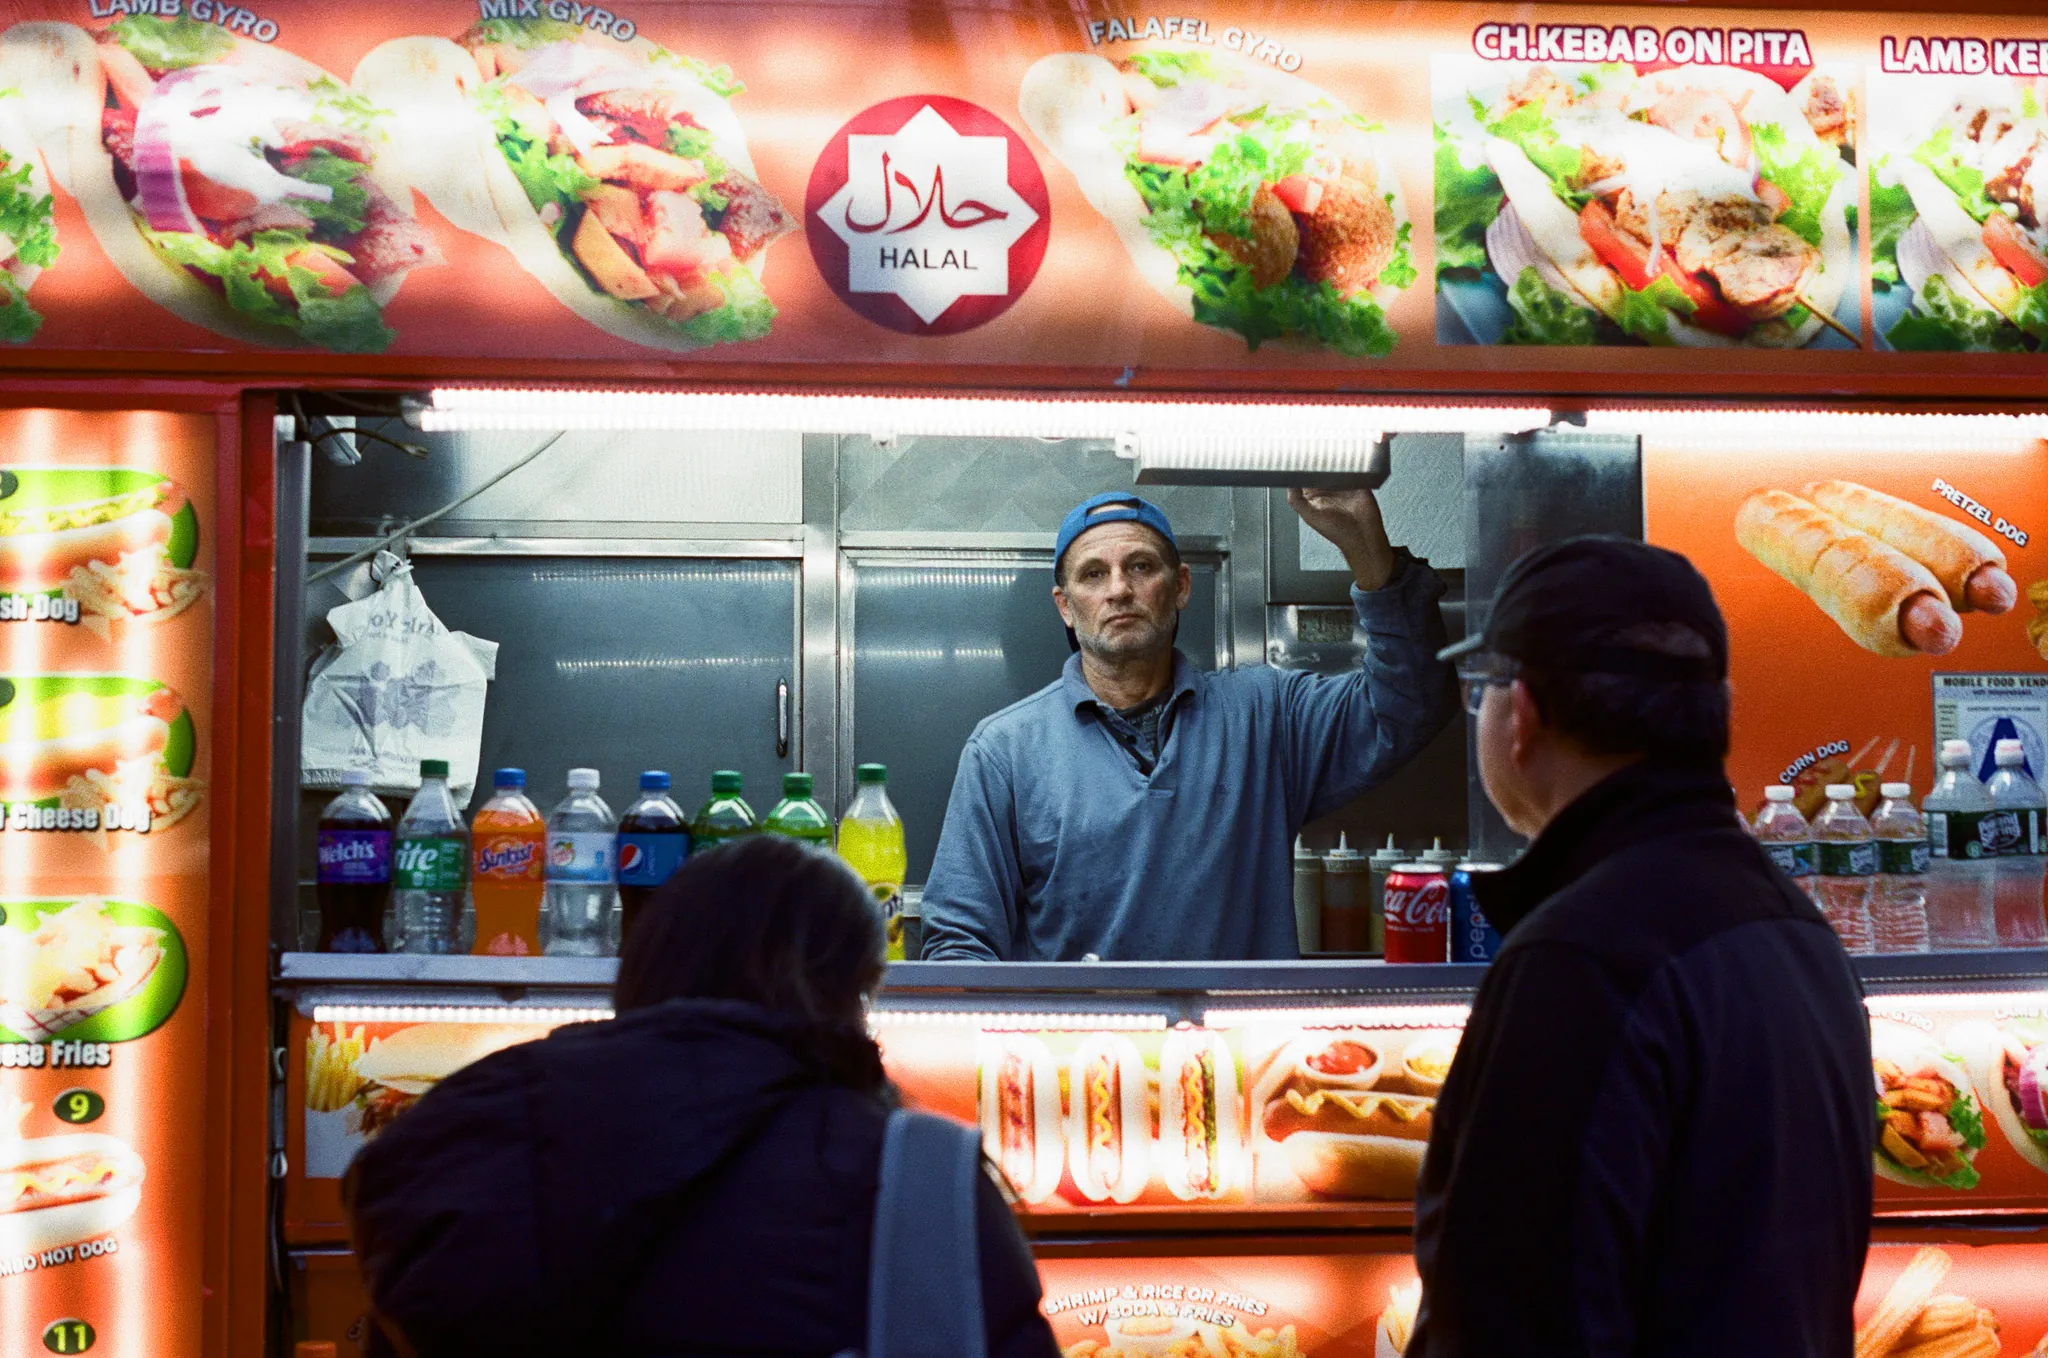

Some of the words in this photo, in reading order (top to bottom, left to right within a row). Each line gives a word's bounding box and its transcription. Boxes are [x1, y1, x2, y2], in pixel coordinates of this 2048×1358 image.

[91, 0, 182, 18] LAMB
[190, 0, 279, 43] GYRO
[480, 0, 539, 19] MIX
[548, 0, 636, 41] GYRO
[1088, 16, 1215, 45] FALAFEL
[1222, 26, 1303, 72] GYRO
[1472, 23, 1660, 64] CH.KEBAB
[1664, 28, 1724, 66] ON
[1728, 29, 1814, 67] PITA
[1882, 37, 1988, 74] LAMB
[845, 151, 1009, 235] حلال
[880, 247, 978, 270] HALAL
[1932, 478, 1993, 527] PRETZEL
[1993, 517, 2029, 548] DOG
[33, 593, 80, 624] Dog
[1943, 677, 1983, 687] MOBILE
[1985, 677, 2016, 687] FOOD
[1779, 751, 1817, 784] CORN
[1816, 740, 1850, 759] DOG
[11, 803, 98, 830] Cheese
[104, 803, 151, 833] Dog
[51, 1040, 111, 1067] Fries
[69, 1093, 90, 1121] 9
[40, 1246, 76, 1268] HOT
[78, 1236, 118, 1259] DOG
[1046, 1286, 1119, 1314] SHRIMP
[1122, 1285, 1138, 1301] &
[1142, 1284, 1185, 1301] RICE
[1187, 1285, 1214, 1303] OR
[1217, 1289, 1269, 1316] FRIES
[1165, 1303, 1180, 1317] &
[1182, 1304, 1236, 1328] FRIES
[53, 1325, 87, 1352] 11
